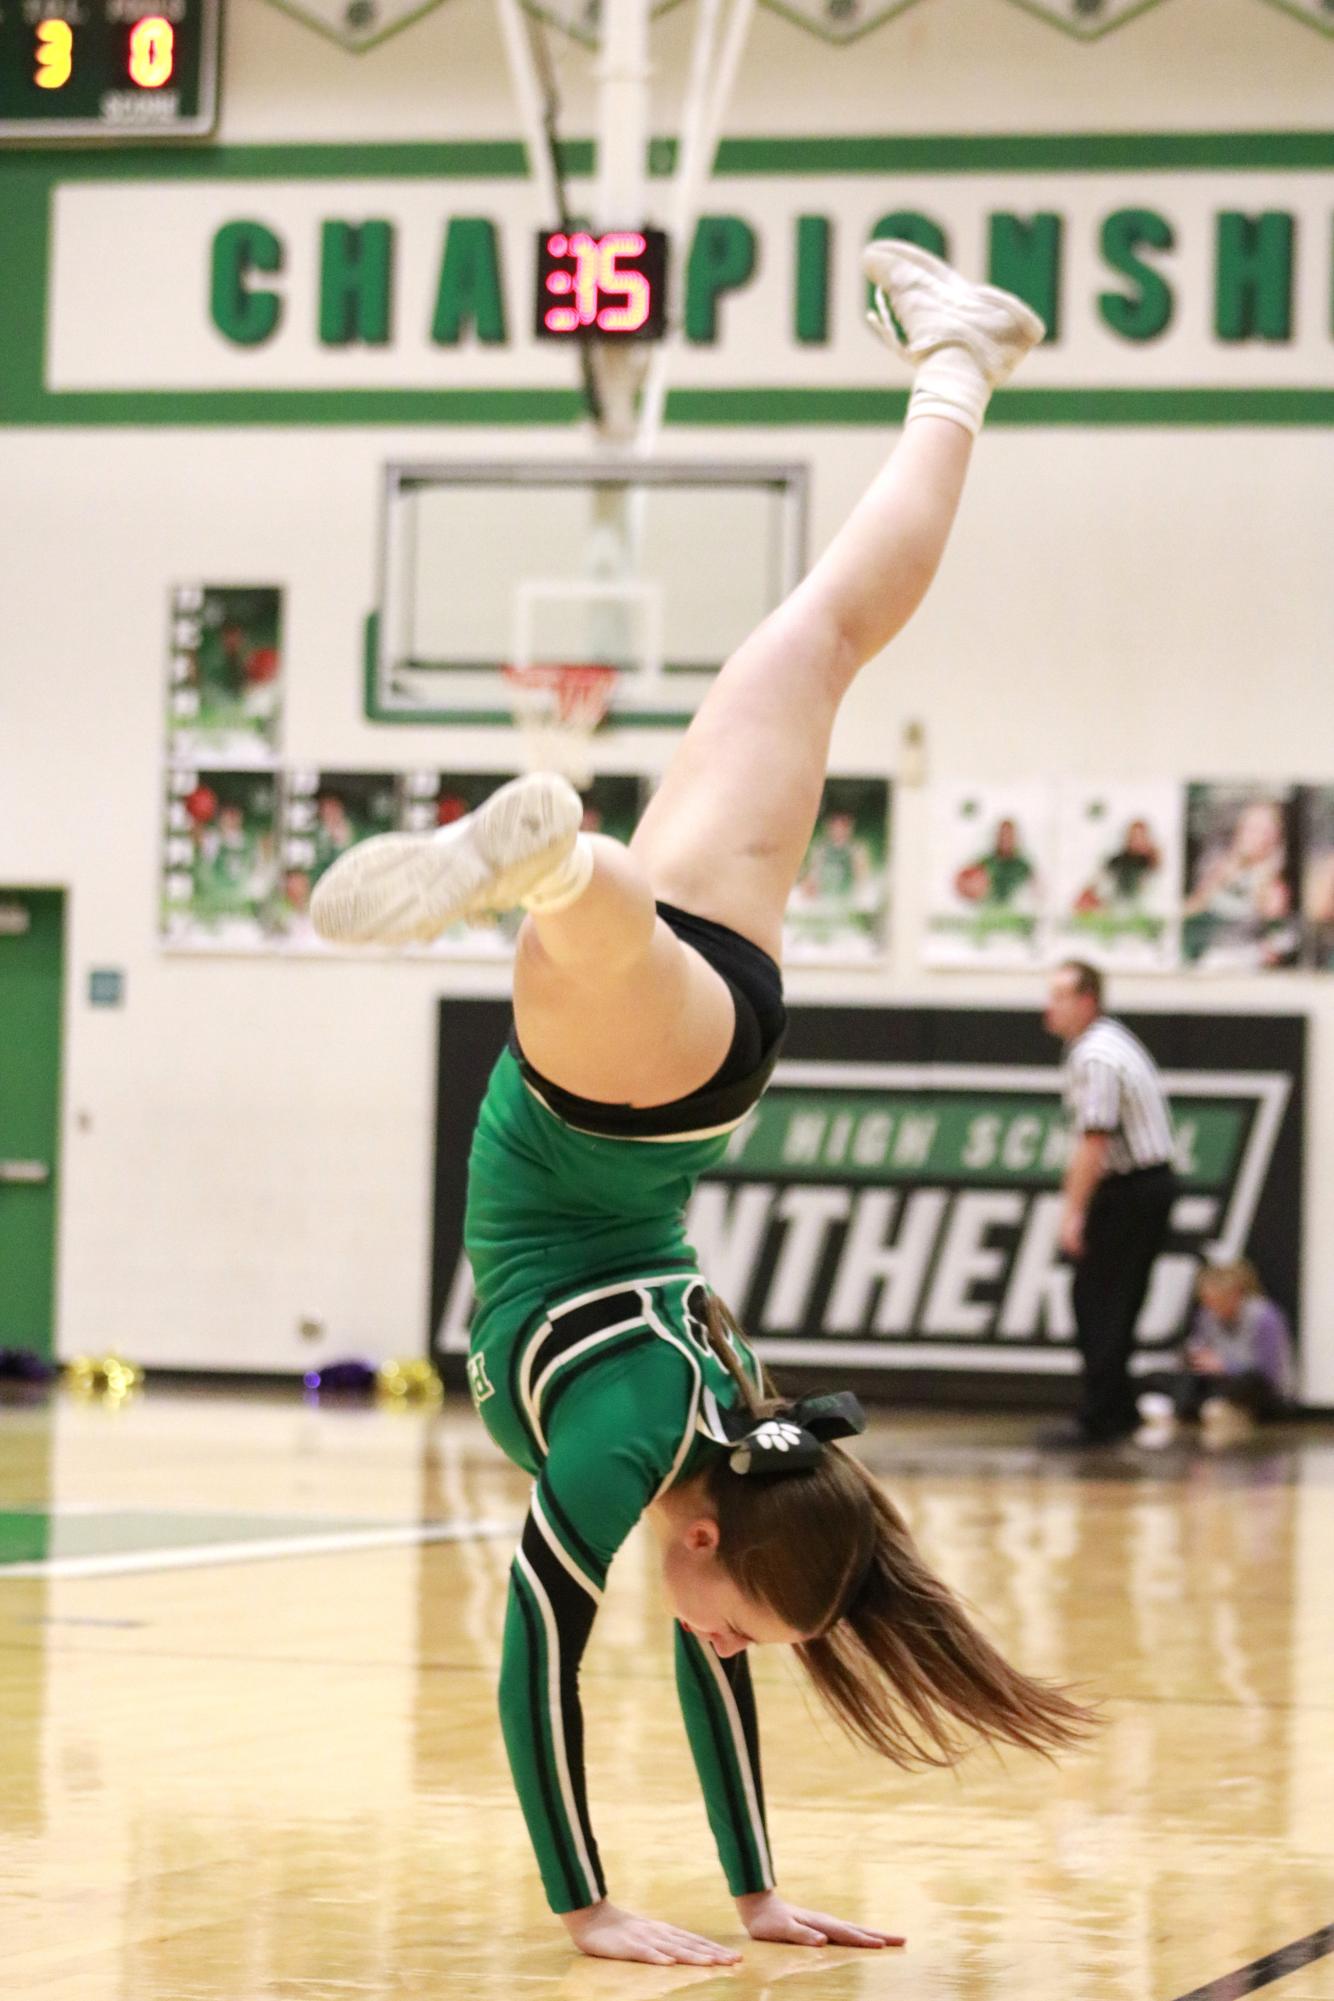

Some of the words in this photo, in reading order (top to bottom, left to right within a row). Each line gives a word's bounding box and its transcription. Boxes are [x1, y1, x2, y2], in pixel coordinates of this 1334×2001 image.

[34, 18, 73, 89] 3
[128, 16, 174, 88] 0
[782, 1108, 938, 1168] HIGH
